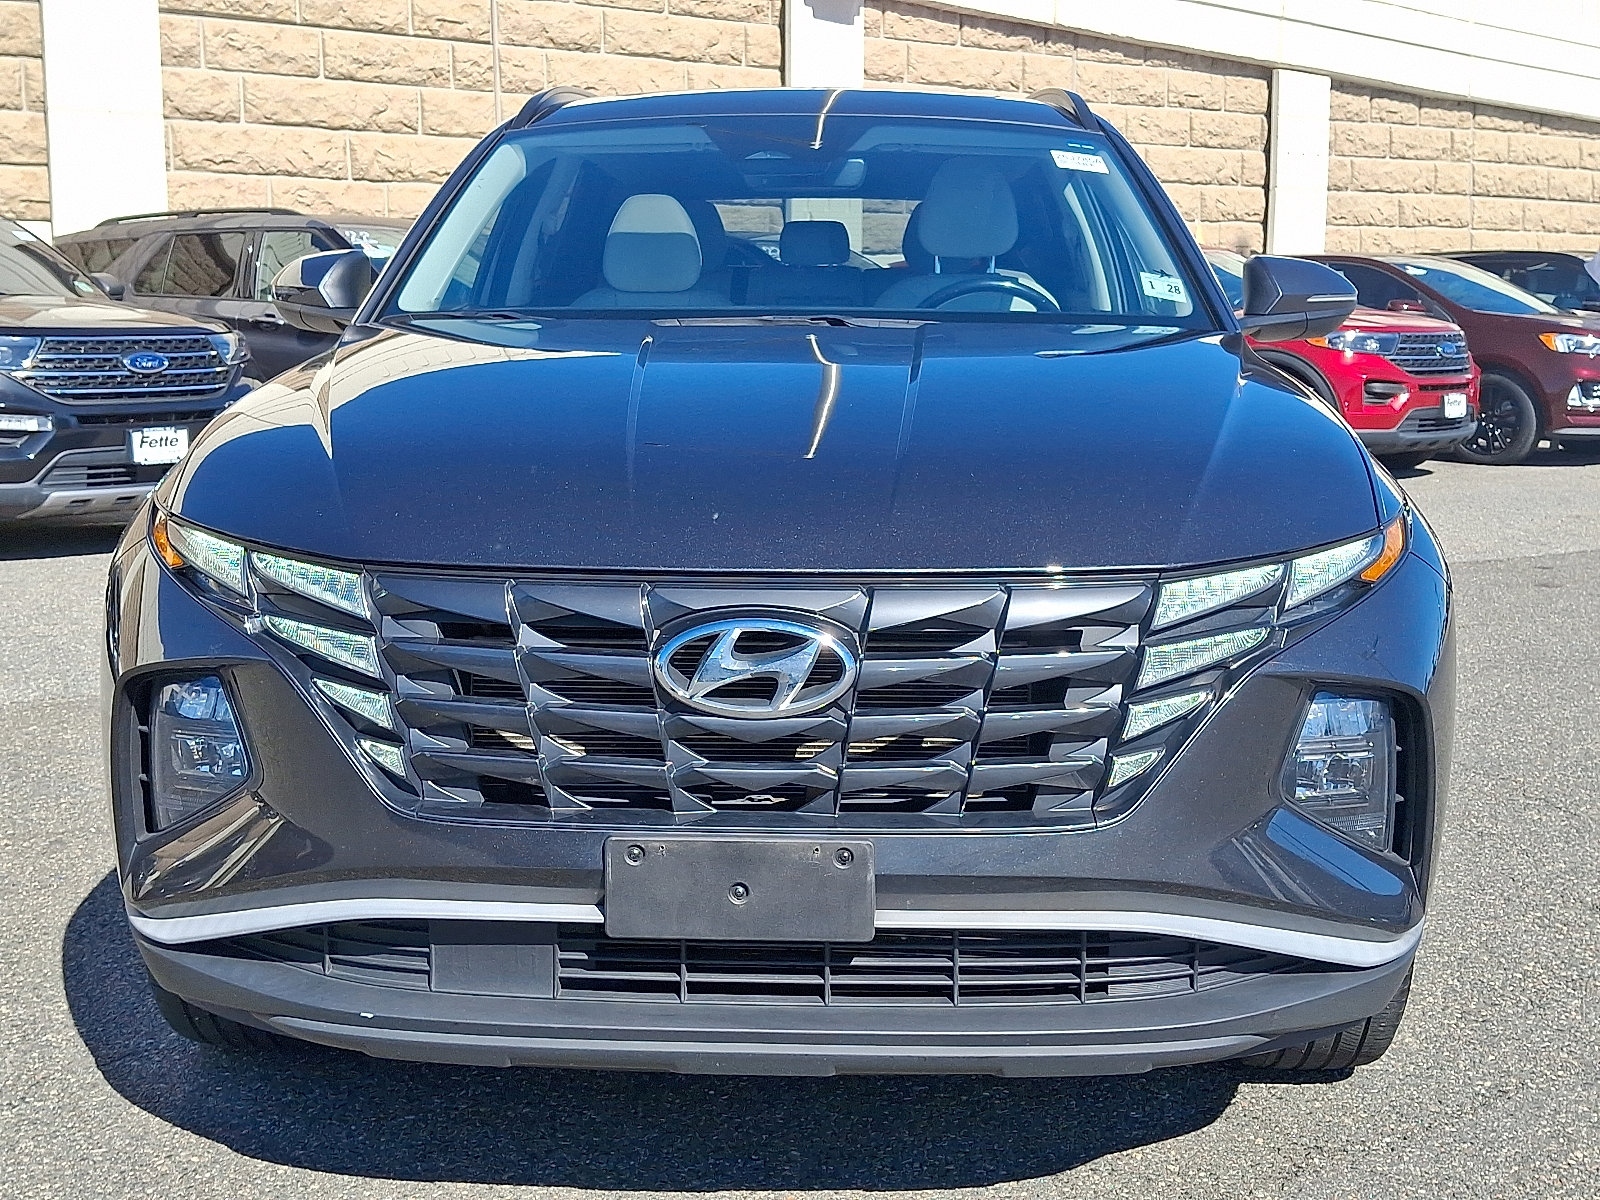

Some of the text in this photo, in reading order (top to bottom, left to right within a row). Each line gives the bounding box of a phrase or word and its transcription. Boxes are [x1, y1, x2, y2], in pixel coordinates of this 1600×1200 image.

[1167, 284, 1181, 294] 28
[135, 357, 160, 368] Ford
[139, 435, 179, 448] Fette
